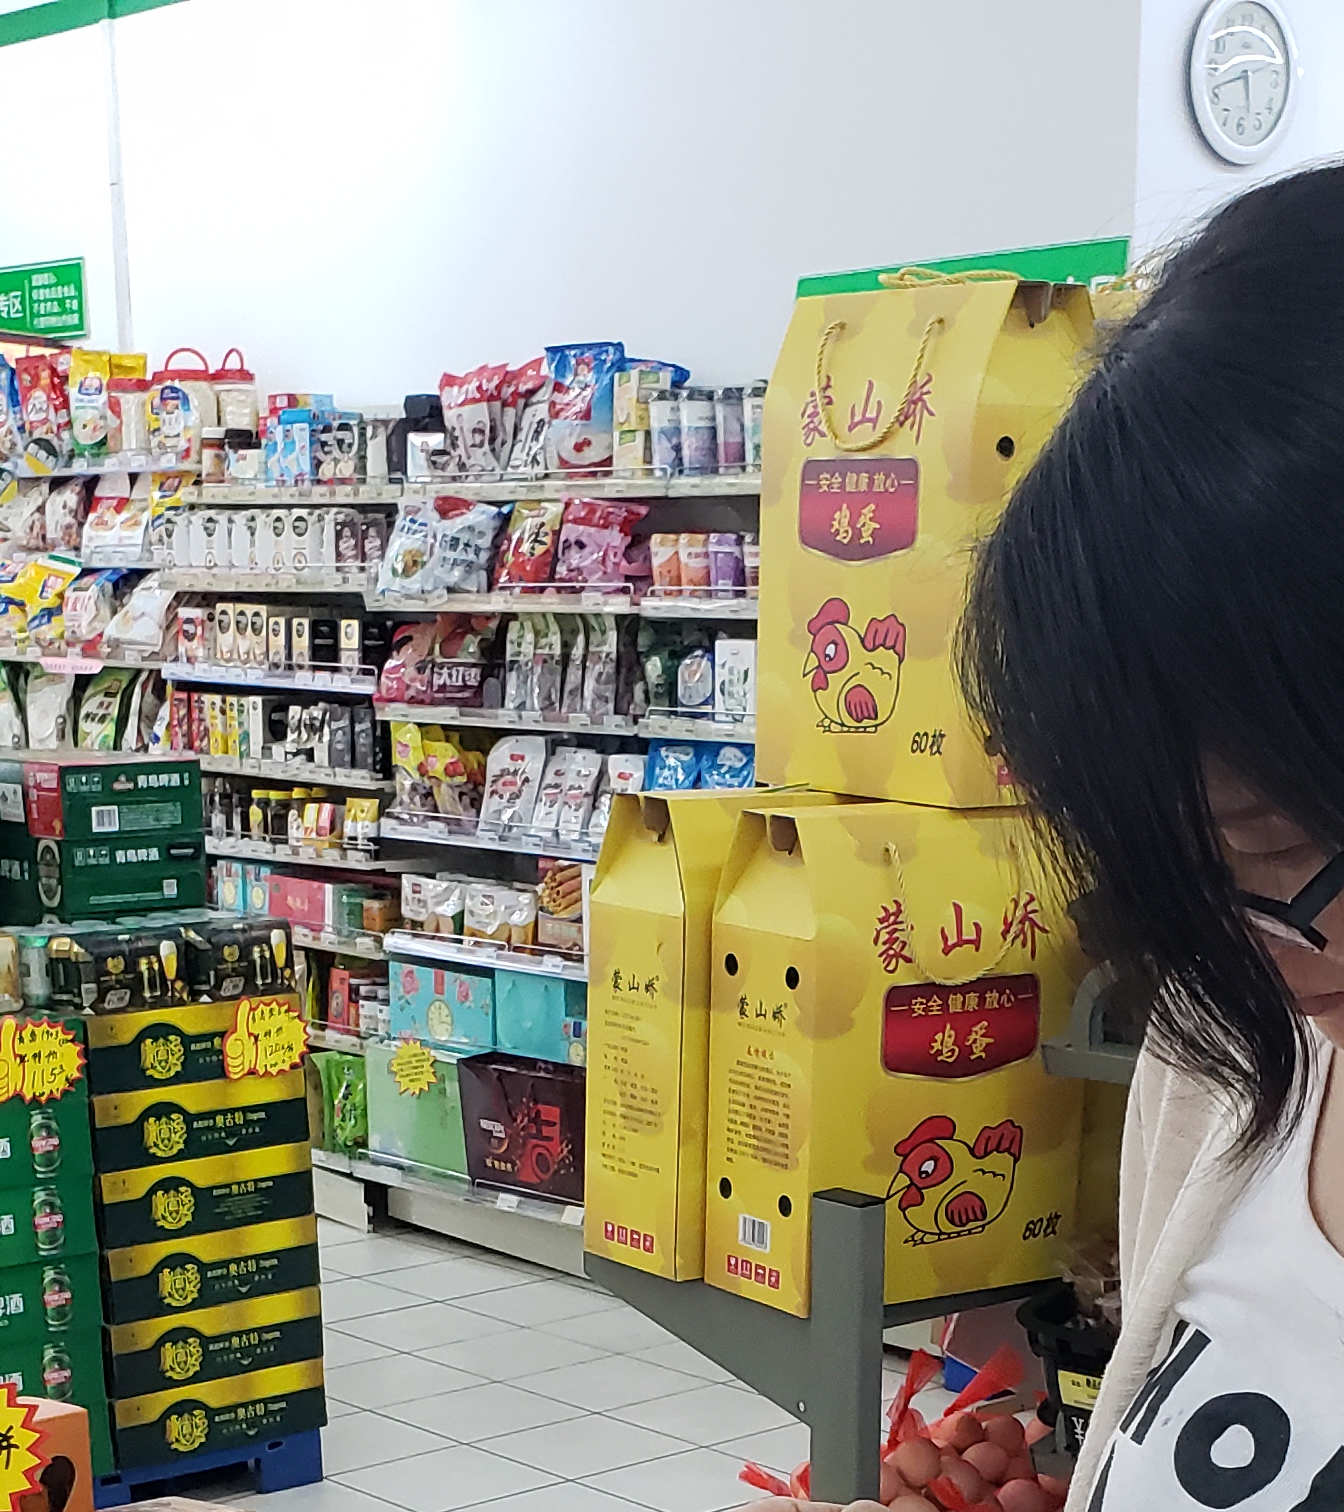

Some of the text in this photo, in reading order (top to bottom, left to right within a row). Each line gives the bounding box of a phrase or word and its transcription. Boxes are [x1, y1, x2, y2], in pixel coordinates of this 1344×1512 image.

[819, 471, 899, 494] 安全 健康 放心
[830, 502, 881, 546] 鸡蛋
[909, 730, 947, 756] 60枚
[910, 986, 1016, 1018] 安全 健康 放心
[928, 1024, 995, 1063] 鸡蛋
[1022, 1210, 1062, 1242] 60枚
